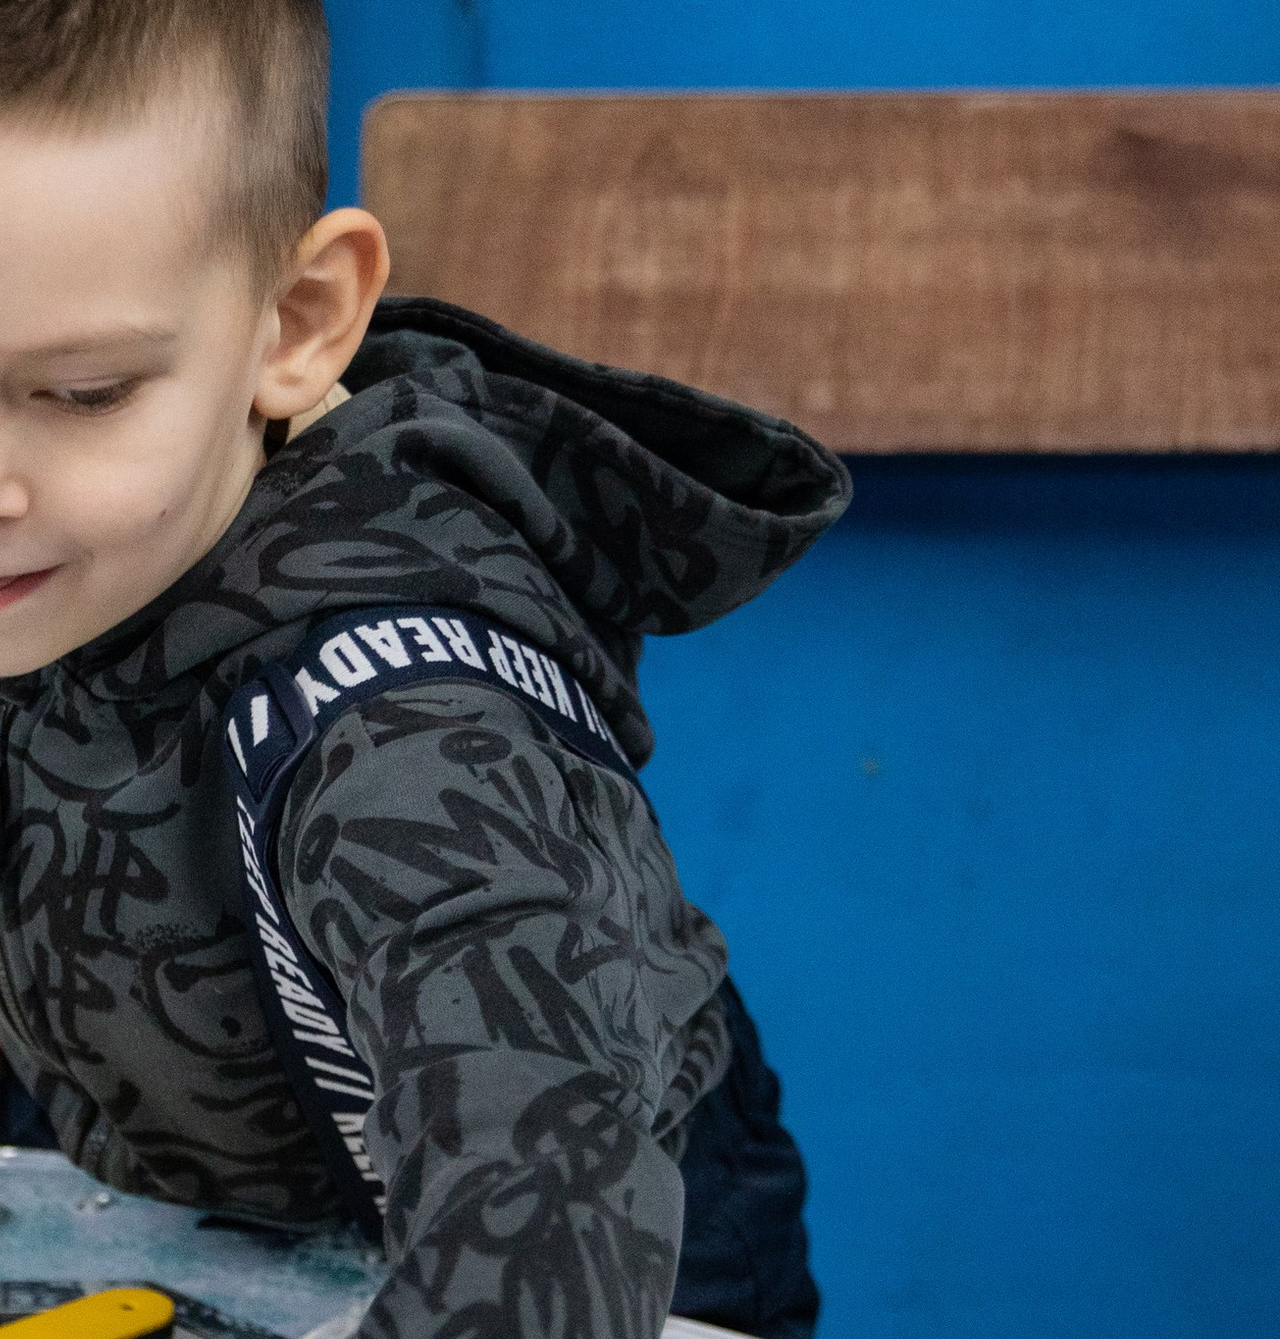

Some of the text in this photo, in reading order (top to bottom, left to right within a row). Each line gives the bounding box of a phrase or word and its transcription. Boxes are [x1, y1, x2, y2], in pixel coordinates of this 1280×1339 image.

[295, 617, 487, 718] READY
[488, 629, 577, 722] KEEP
[255, 912, 356, 1058] READY
